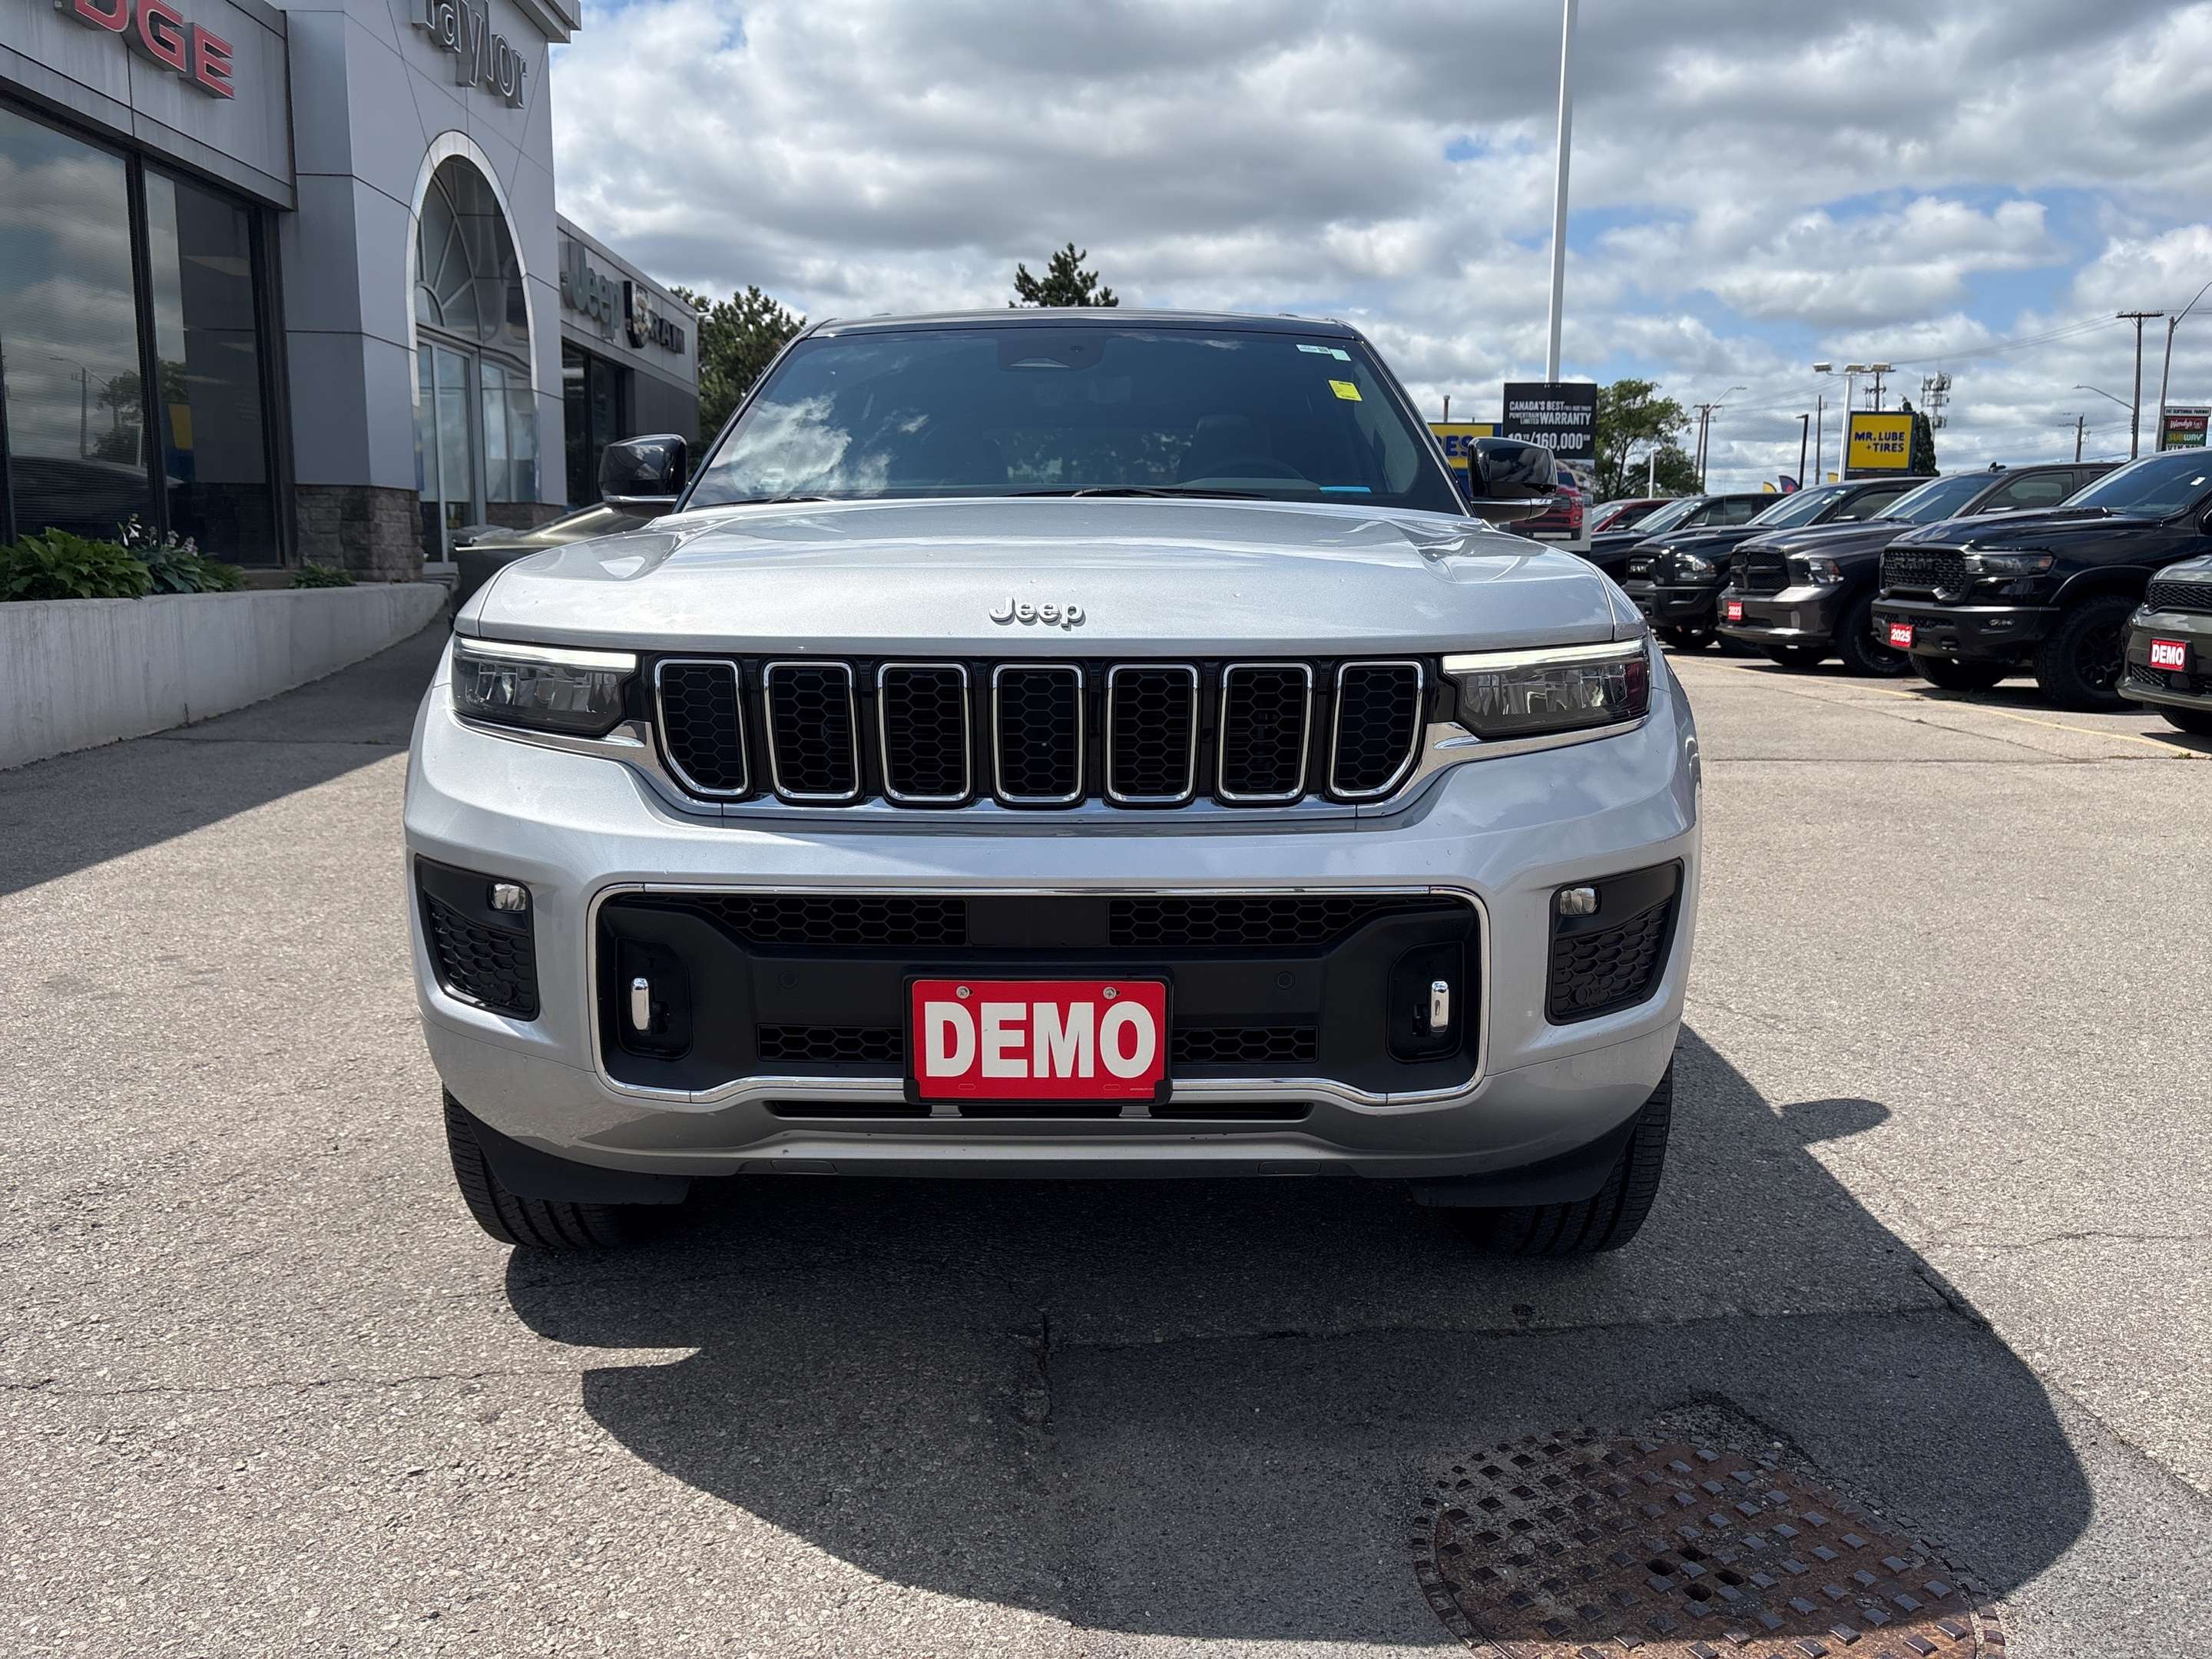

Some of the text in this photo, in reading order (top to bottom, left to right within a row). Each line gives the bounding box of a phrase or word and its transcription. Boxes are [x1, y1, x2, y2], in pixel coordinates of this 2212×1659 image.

[424, 0, 529, 108] aylor
[559, 242, 624, 343] Jeep
[649, 309, 686, 354] RAM
[1509, 401, 1545, 411] CANADA'S
[1546, 401, 1565, 411] BEST
[1540, 412, 1592, 426] WARRANTY
[1854, 432, 1905, 442] MR. LUBE
[2168, 432, 2204, 442] SUBWAY
[988, 596, 1085, 630] Jeep
[1891, 628, 1911, 643] 2025
[2151, 644, 2184, 666] DEMO
[924, 1001, 1156, 1078] DEMO
